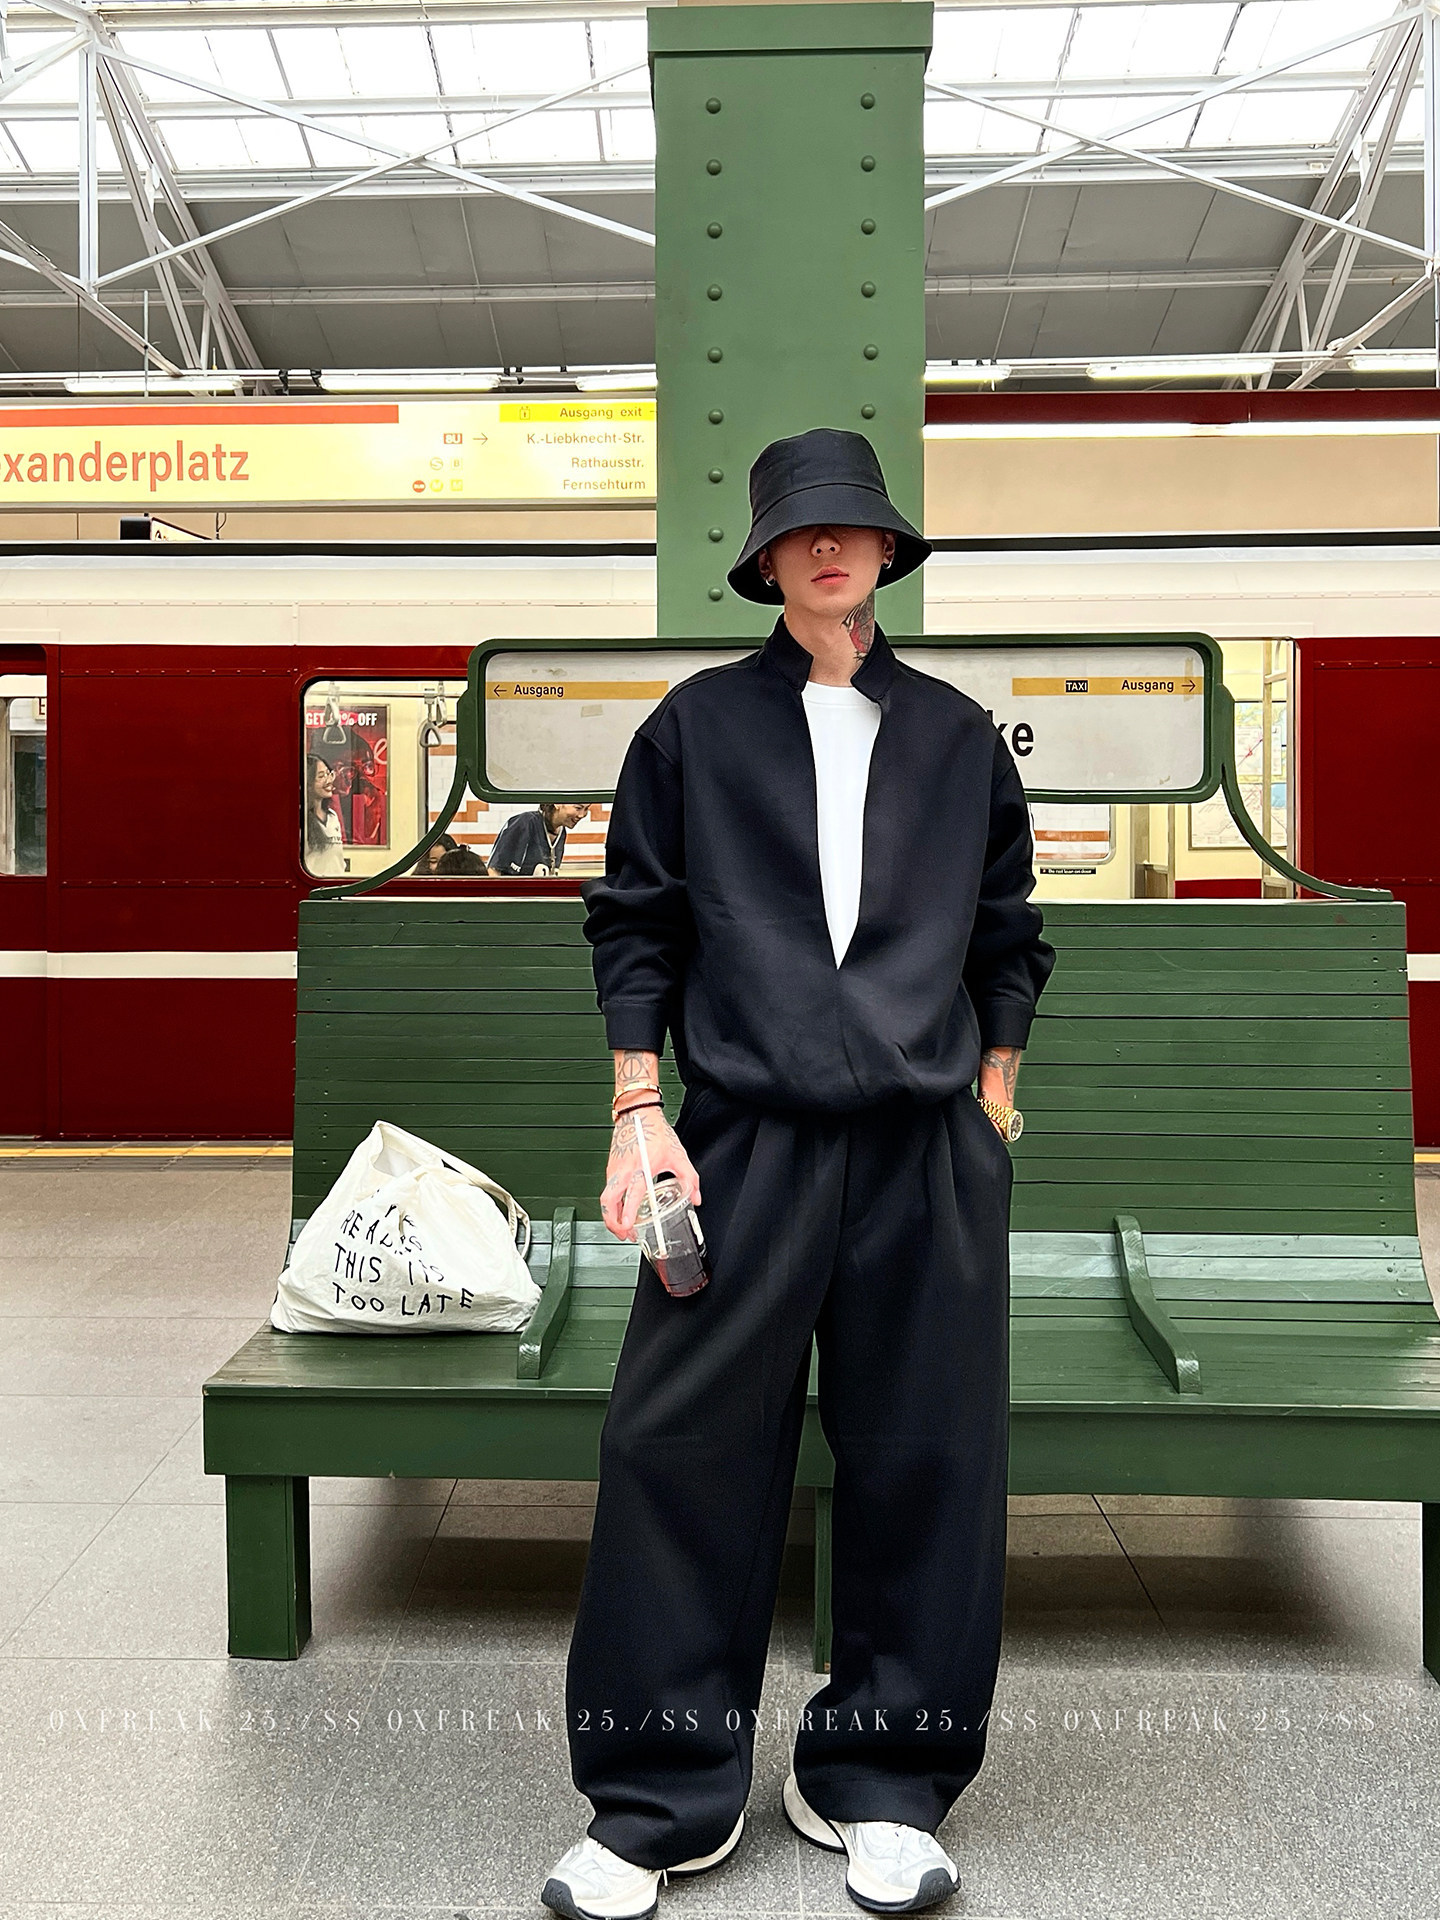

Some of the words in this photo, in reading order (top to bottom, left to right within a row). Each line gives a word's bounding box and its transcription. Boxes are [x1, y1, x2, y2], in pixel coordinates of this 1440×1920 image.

[559, 407, 613, 420] Ausgang
[620, 406, 642, 417] exit
[527, 432, 645, 444] K.-Liebknecht-Str.
[571, 457, 645, 468] Rathausstr.
[563, 479, 646, 490] Fernsehturm
[513, 684, 564, 698] Ausgang
[1066, 681, 1088, 692] TAXI
[1121, 680, 1174, 692] Ausgang
[305, 712, 326, 726] GET
[357, 712, 378, 726] OFF
[334, 1242, 382, 1283] THIS
[332, 1281, 385, 1312] TOO
[401, 1287, 474, 1316] LATE
